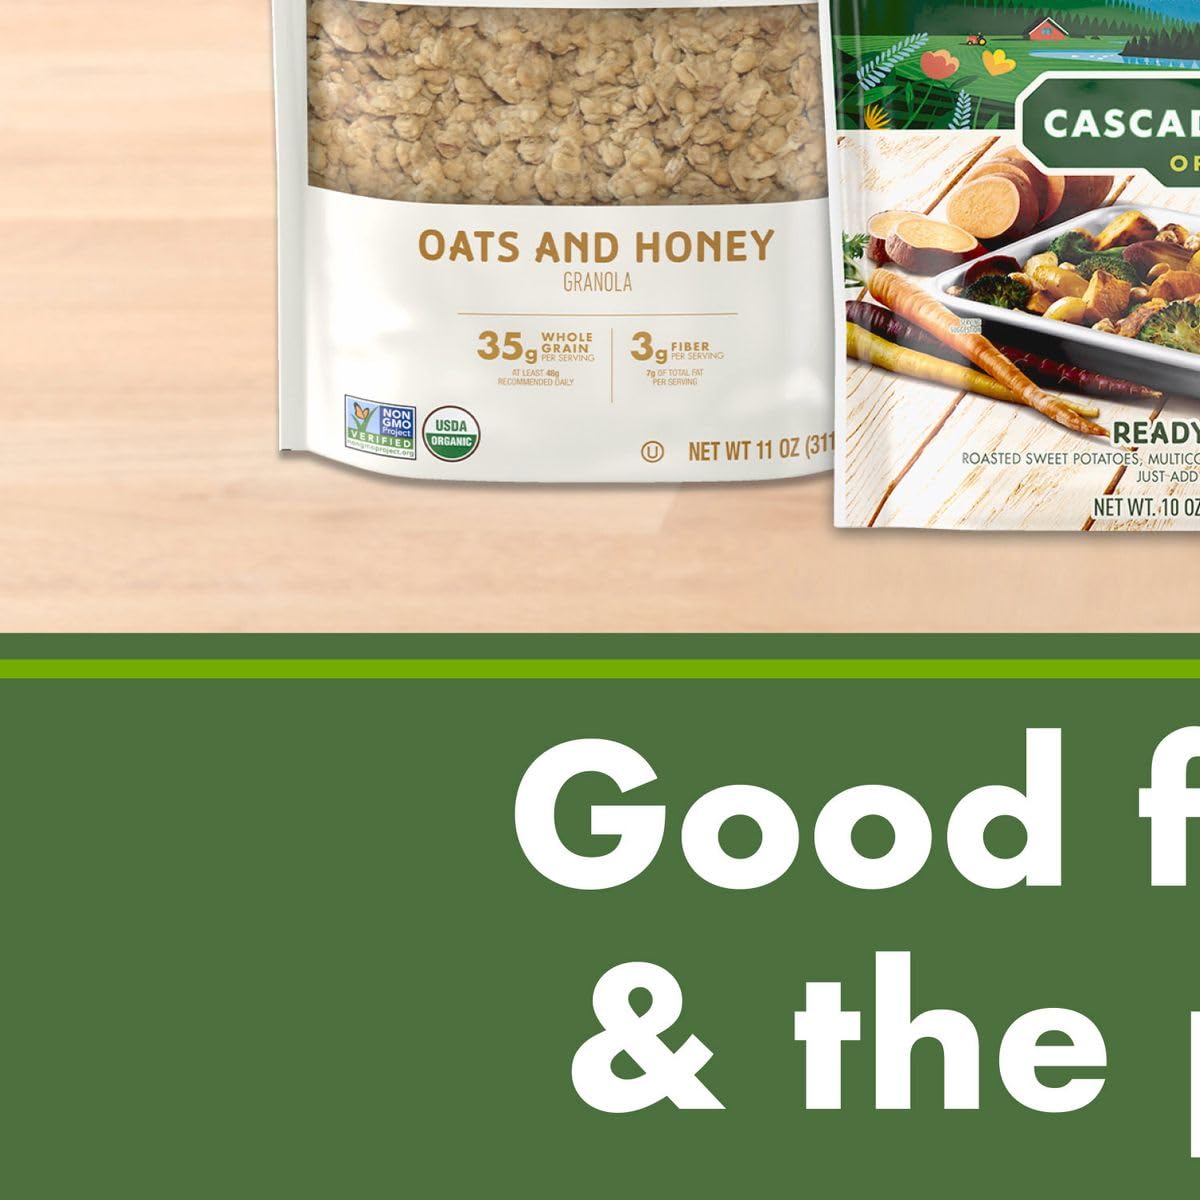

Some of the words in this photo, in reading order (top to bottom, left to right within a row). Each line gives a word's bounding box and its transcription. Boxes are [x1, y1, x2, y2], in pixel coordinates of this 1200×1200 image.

[418, 229, 520, 263] OATS
[535, 231, 619, 263] AND
[635, 229, 775, 262] HONEY
[563, 271, 633, 293] GRANOLA
[541, 332, 593, 342] WHOLE
[477, 330, 538, 365] 35g
[541, 343, 589, 353] GRAIN
[630, 331, 668, 365] 3g
[671, 341, 710, 351] FIBER
[541, 354, 555, 362] PER
[557, 354, 595, 362] SERVING
[671, 352, 685, 360] PER
[687, 352, 724, 360] SERVING
[383, 408, 411, 420] NON
[382, 418, 411, 429] GMO
[436, 420, 467, 432] USDA
[382, 426, 411, 438] Project
[351, 430, 411, 448] VERIFIED
[431, 436, 472, 447] ORGANIC
[689, 441, 720, 461] NET
[725, 441, 752, 460] WT
[756, 440, 772, 459] 11
[779, 437, 800, 458] OZ
[962, 453, 1021, 465] ROASTED
[1026, 453, 1067, 465] SWEET
[1073, 453, 1143, 467] POTATOES,
[1136, 471, 1165, 483] JUST
[1170, 471, 1198, 483] ADD
[1094, 498, 1124, 516] NET
[1127, 498, 1156, 516] WT.
[1161, 498, 1178, 516] 10
